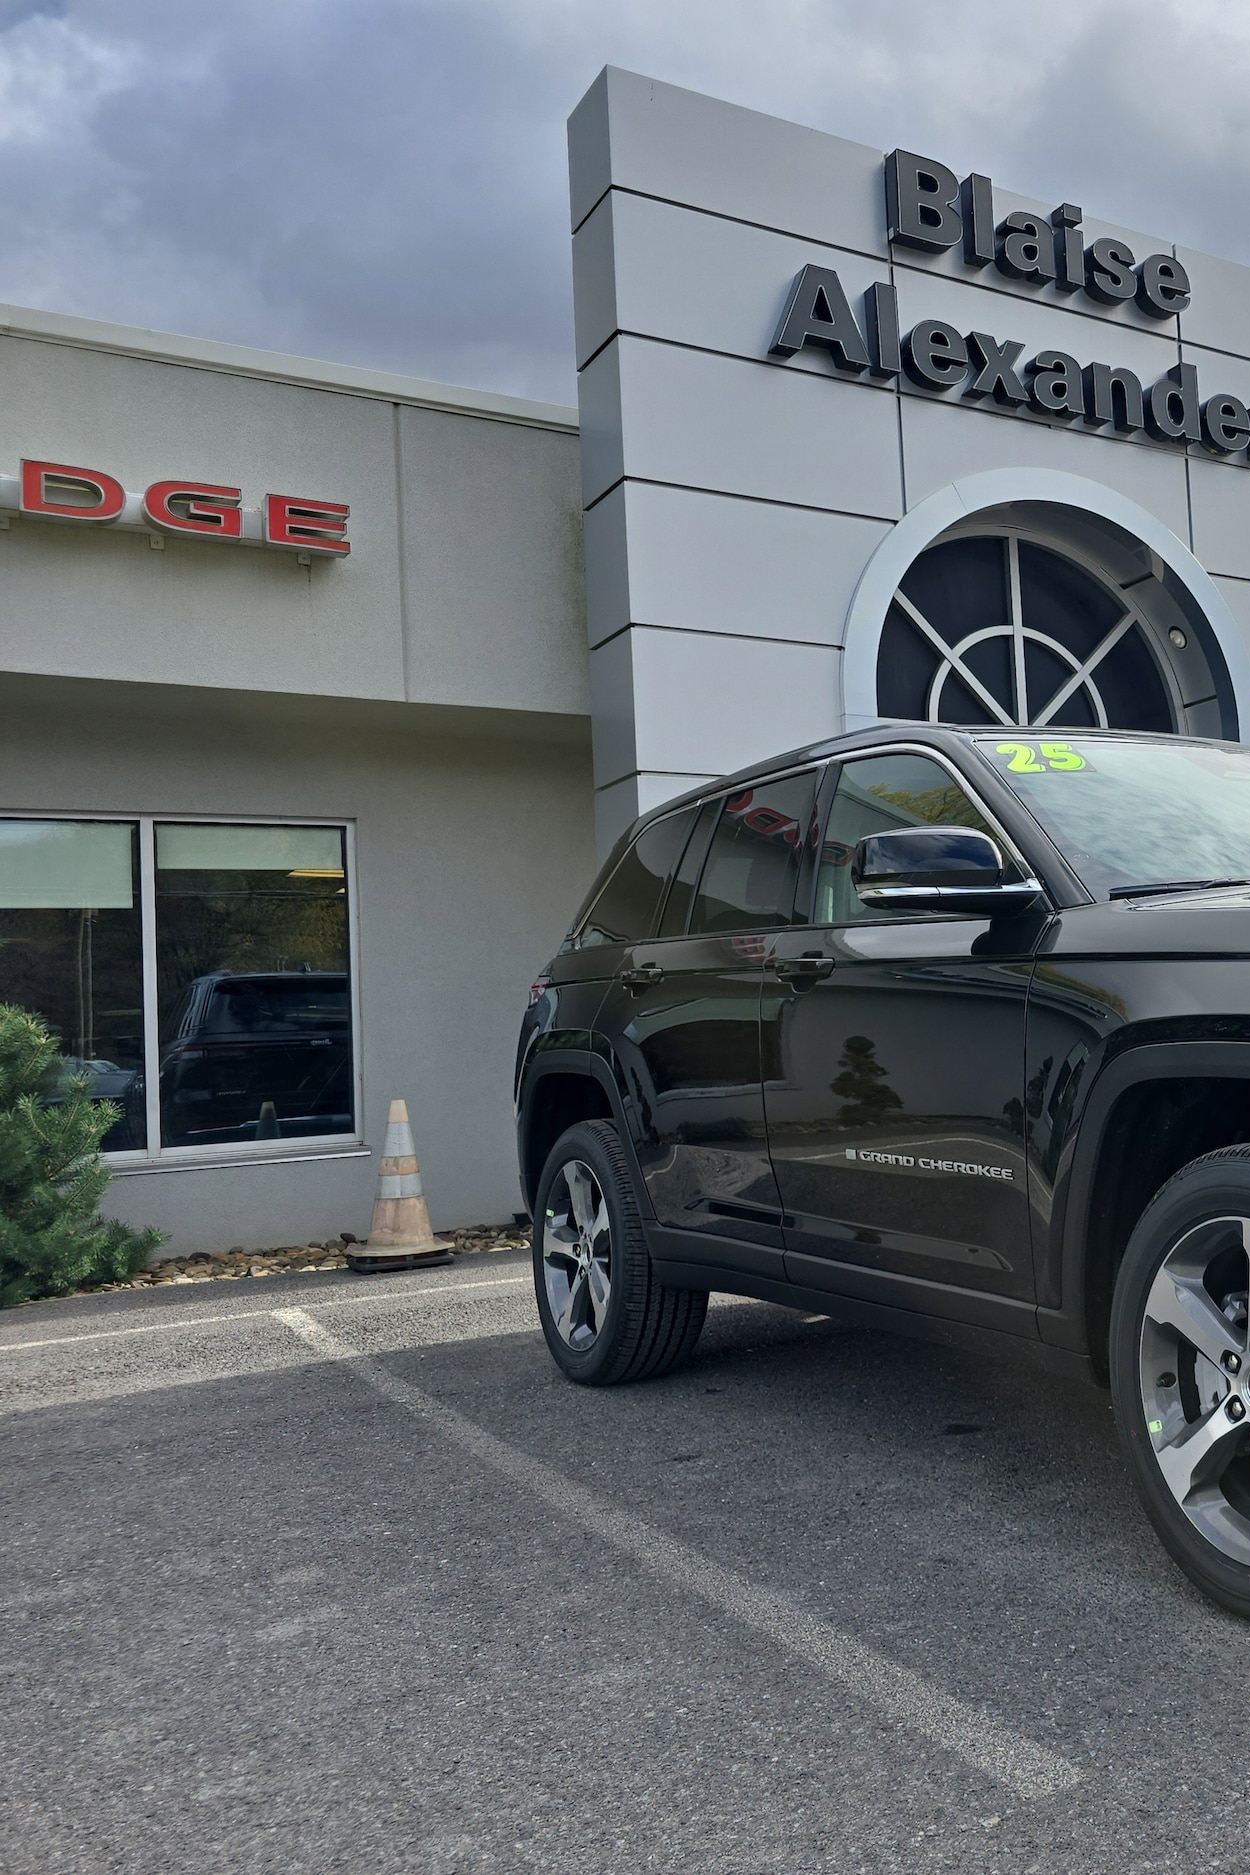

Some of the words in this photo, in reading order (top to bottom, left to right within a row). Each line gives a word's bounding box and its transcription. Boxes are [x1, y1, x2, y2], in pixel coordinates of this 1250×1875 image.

[886, 148, 1191, 319] Blaise
[20, 459, 351, 558] DGE
[996, 743, 1086, 773] 25
[859, 1151, 915, 1168] GRAND
[918, 1158, 1014, 1181] CHEROKEE
